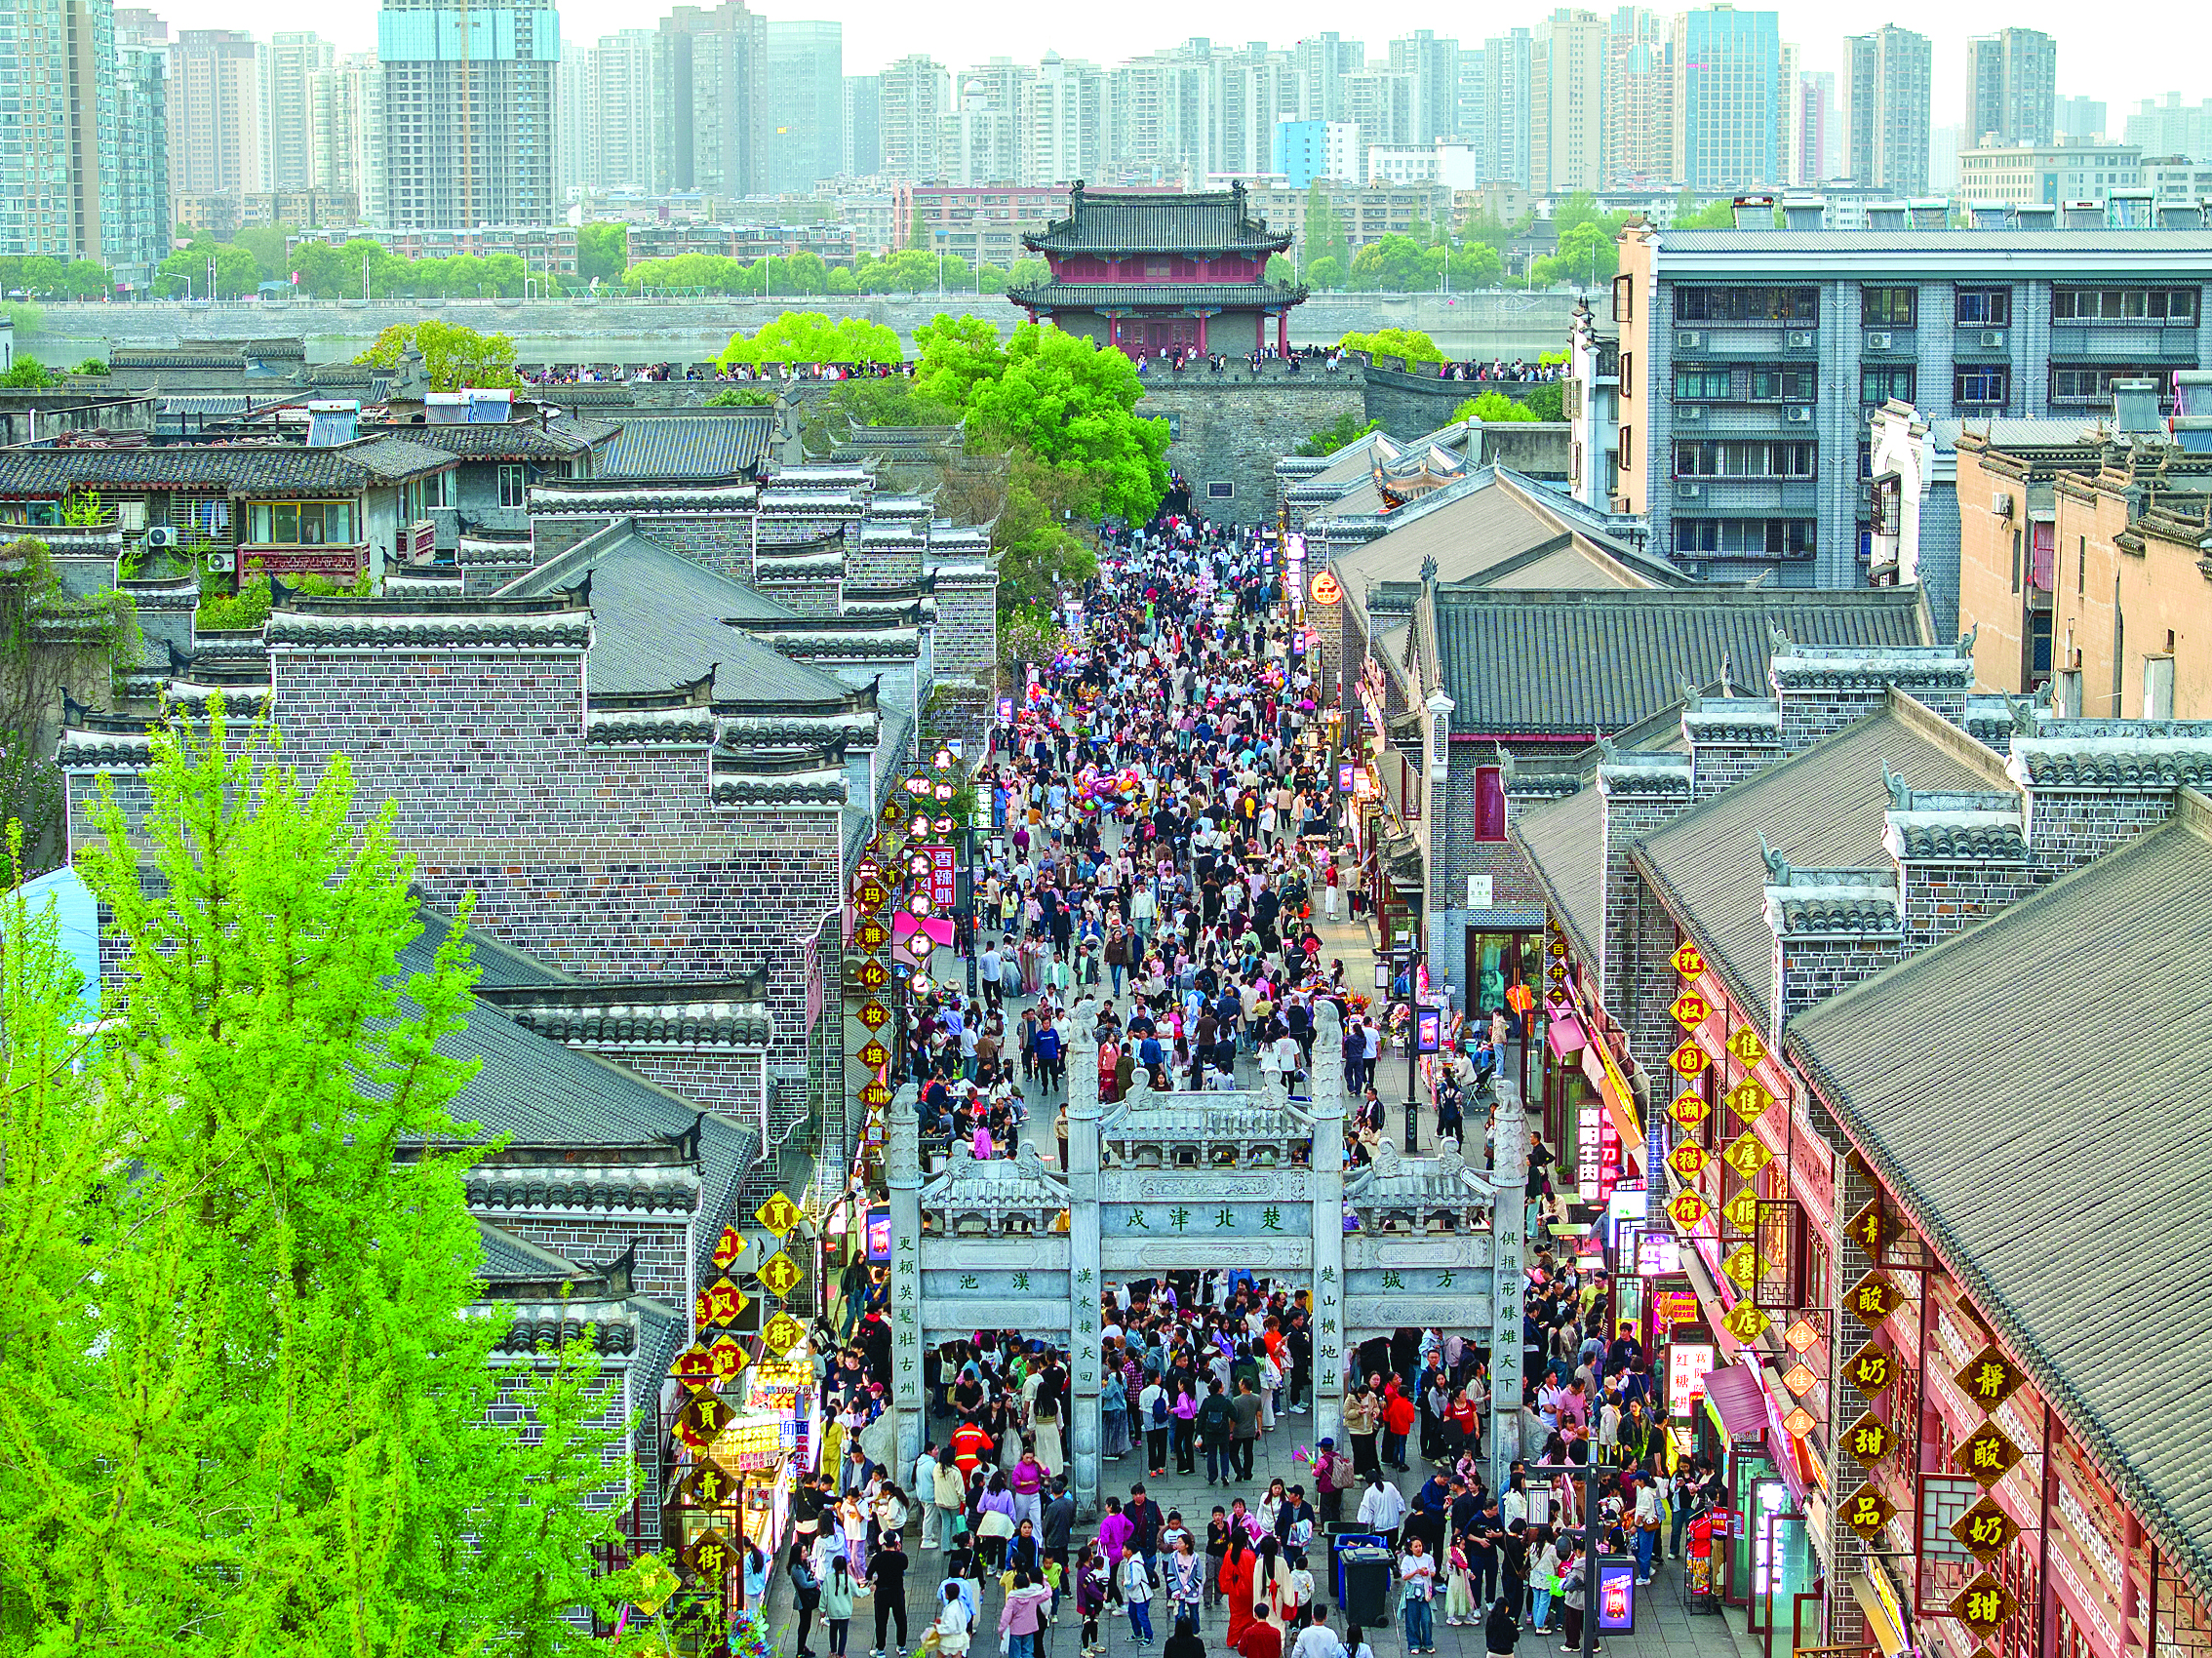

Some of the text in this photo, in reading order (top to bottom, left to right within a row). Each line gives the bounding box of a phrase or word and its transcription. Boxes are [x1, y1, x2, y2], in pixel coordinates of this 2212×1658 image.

[934, 851, 952, 903] 香辣虾
[864, 888, 885, 1105] 玛雅化妆培训
[1579, 1108, 1600, 1200] 襄阳牛肉面
[1676, 951, 1701, 1220] 狸奴国潮猫馆
[1735, 1034, 1759, 1333] 佳佳屋服装店
[770, 1203, 794, 1347] 買賣街
[1792, 1329, 1808, 1431] 佳佳屋
[696, 1401, 726, 1570] 買賣街
